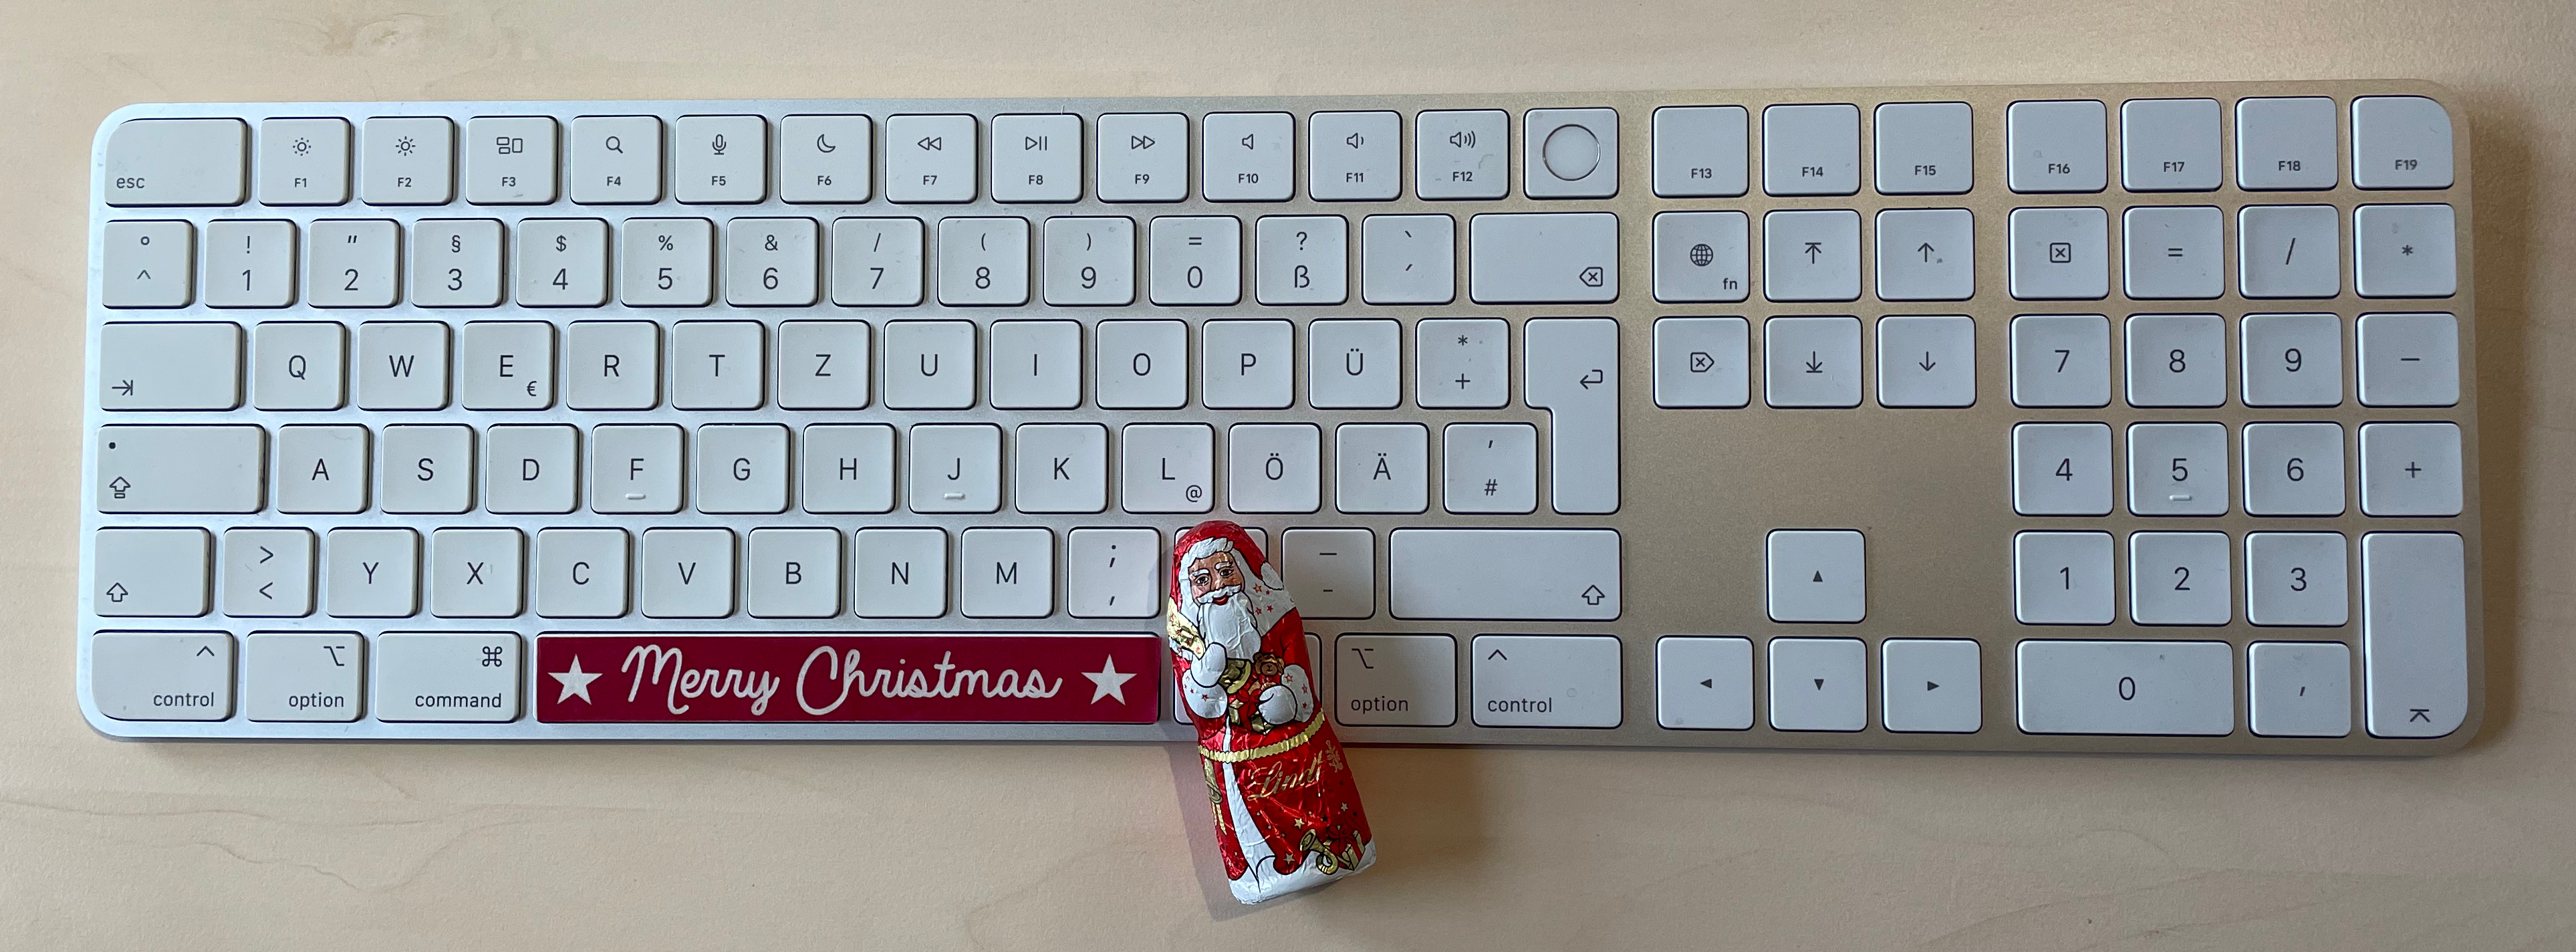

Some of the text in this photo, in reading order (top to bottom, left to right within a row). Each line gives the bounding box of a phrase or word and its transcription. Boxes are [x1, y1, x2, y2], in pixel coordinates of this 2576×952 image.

[1452, 170, 1474, 183] F12
[1690, 167, 1713, 180] F13
[1801, 166, 1824, 178] F14
[1914, 164, 1937, 176] F15
[2047, 162, 2071, 175] F16
[2163, 160, 2186, 173] F17
[2277, 160, 2302, 172] F18
[2394, 158, 2418, 171] F19
[116, 176, 146, 190] esc
[293, 176, 307, 189] F1
[396, 176, 412, 189] F2
[501, 176, 517, 188] F3
[606, 175, 622, 187] F4
[711, 174, 727, 187] F5
[817, 174, 833, 187] F6
[922, 174, 938, 187] F7
[1028, 174, 1044, 186] F8
[1134, 173, 1150, 185] F9
[1237, 172, 1259, 185] F10
[1345, 171, 1364, 184] F11
[450, 234, 461, 254] §
[555, 234, 567, 253] $
[658, 234, 674, 252] %
[764, 233, 779, 252] &
[873, 231, 882, 253] /
[1188, 236, 1203, 246] =
[1295, 231, 1308, 251] ?
[2167, 247, 2184, 258] =
[2285, 237, 2297, 266] /
[241, 269, 251, 292] 1
[344, 267, 359, 291] 2
[446, 267, 463, 291] 3
[551, 267, 569, 291] 4
[657, 267, 674, 291] 5
[762, 266, 779, 291] 6
[869, 266, 885, 290] 7
[975, 265, 991, 290] 8
[1080, 265, 1098, 290] 9
[1186, 265, 1204, 289] 0
[1293, 264, 1311, 289] ß
[1722, 277, 1738, 291] fn
[288, 354, 307, 381] Q
[388, 354, 416, 378] W
[499, 354, 515, 378] E
[603, 354, 620, 378] R
[708, 354, 727, 378] T
[814, 353, 832, 377] Z
[920, 353, 939, 378] U
[1132, 352, 1152, 377] O
[1240, 352, 1257, 377] P
[1345, 347, 1364, 377] Ü
[2054, 349, 2071, 374] 7
[2168, 348, 2187, 374] 8
[2284, 347, 2303, 373] 9
[525, 380, 538, 398] €
[1454, 372, 1472, 390] +
[311, 457, 330, 481] A
[416, 457, 434, 482] S
[521, 457, 541, 482] D
[630, 457, 645, 481] F
[733, 457, 751, 482] G
[839, 457, 858, 481] H
[946, 457, 961, 481] J
[1053, 457, 1071, 481] K
[1161, 457, 1176, 481] L
[1265, 452, 1284, 481] Ö
[1372, 452, 1392, 481] Ä
[2055, 457, 2074, 482] 4
[2171, 457, 2189, 483] 5
[2286, 457, 2305, 483] 6
[2404, 461, 2422, 479] +
[1184, 484, 1203, 503] @
[1483, 478, 1499, 497] #
[259, 545, 275, 565] >
[362, 561, 380, 585] Y
[465, 561, 485, 586] X
[571, 561, 590, 586] C
[677, 562, 697, 586] V
[785, 561, 803, 586] B
[890, 561, 910, 586] N
[995, 561, 1018, 586] M
[2059, 566, 2070, 591] 1
[2174, 566, 2191, 592] 2
[2289, 566, 2308, 592] 3
[258, 580, 274, 600] <
[620, 643, 1063, 717] Merry Christmas
[2117, 676, 2136, 701] 0
[152, 691, 215, 708] control
[288, 691, 345, 711] option
[414, 692, 502, 709] command
[1350, 696, 1409, 715] option
[1487, 696, 1553, 713] control
[1246, 747, 1327, 802] Lindt
